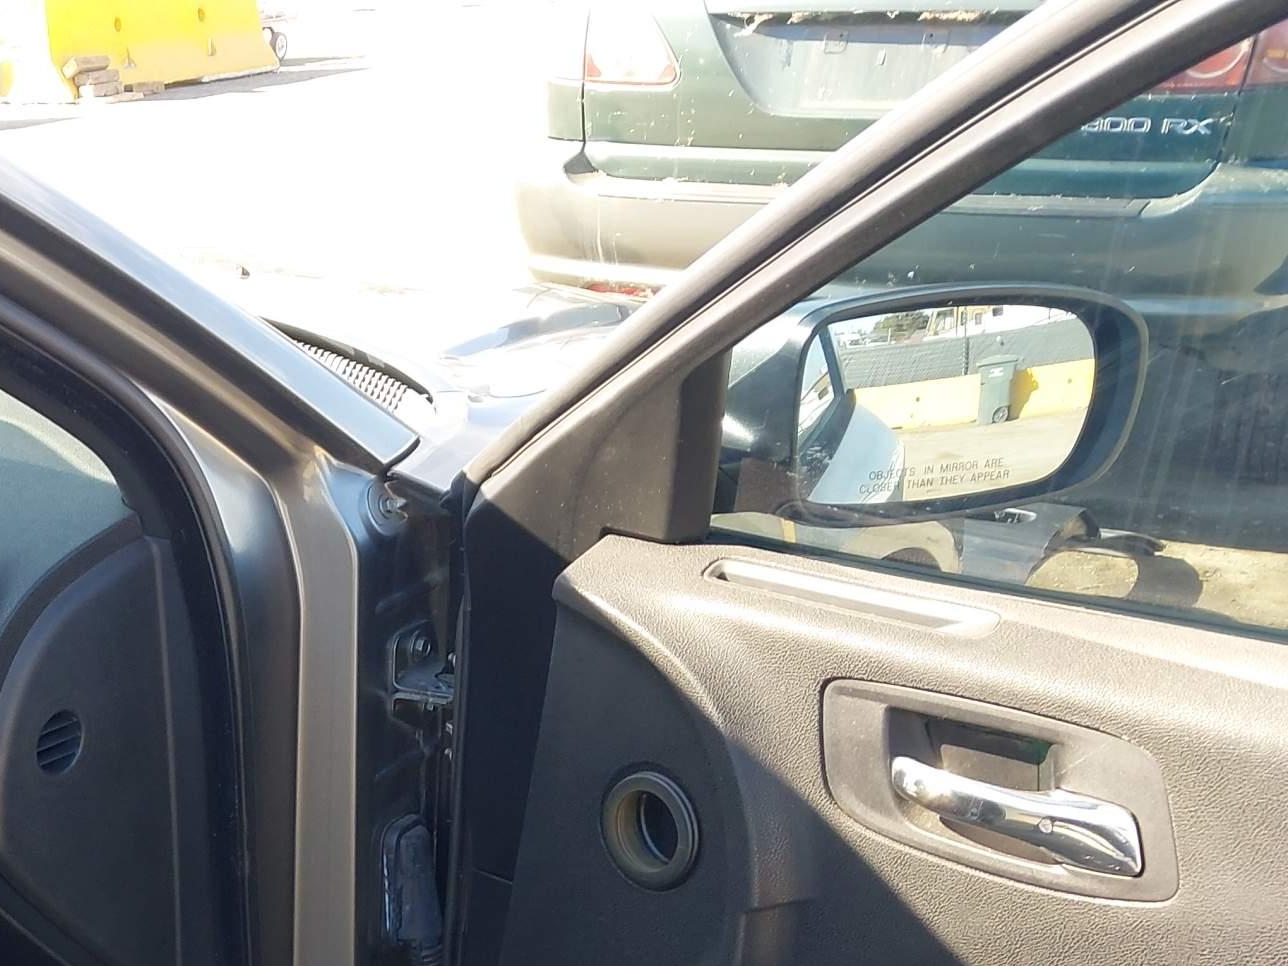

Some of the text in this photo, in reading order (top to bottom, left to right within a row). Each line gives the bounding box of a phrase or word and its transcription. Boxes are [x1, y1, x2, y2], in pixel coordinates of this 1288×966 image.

[1161, 118, 1214, 135] RX
[869, 456, 1005, 482] OBJECTS IN MIRROR ARE
[906, 477, 934, 490] THAN
[939, 474, 965, 486] THEY
[969, 468, 1011, 482] APPEAR
